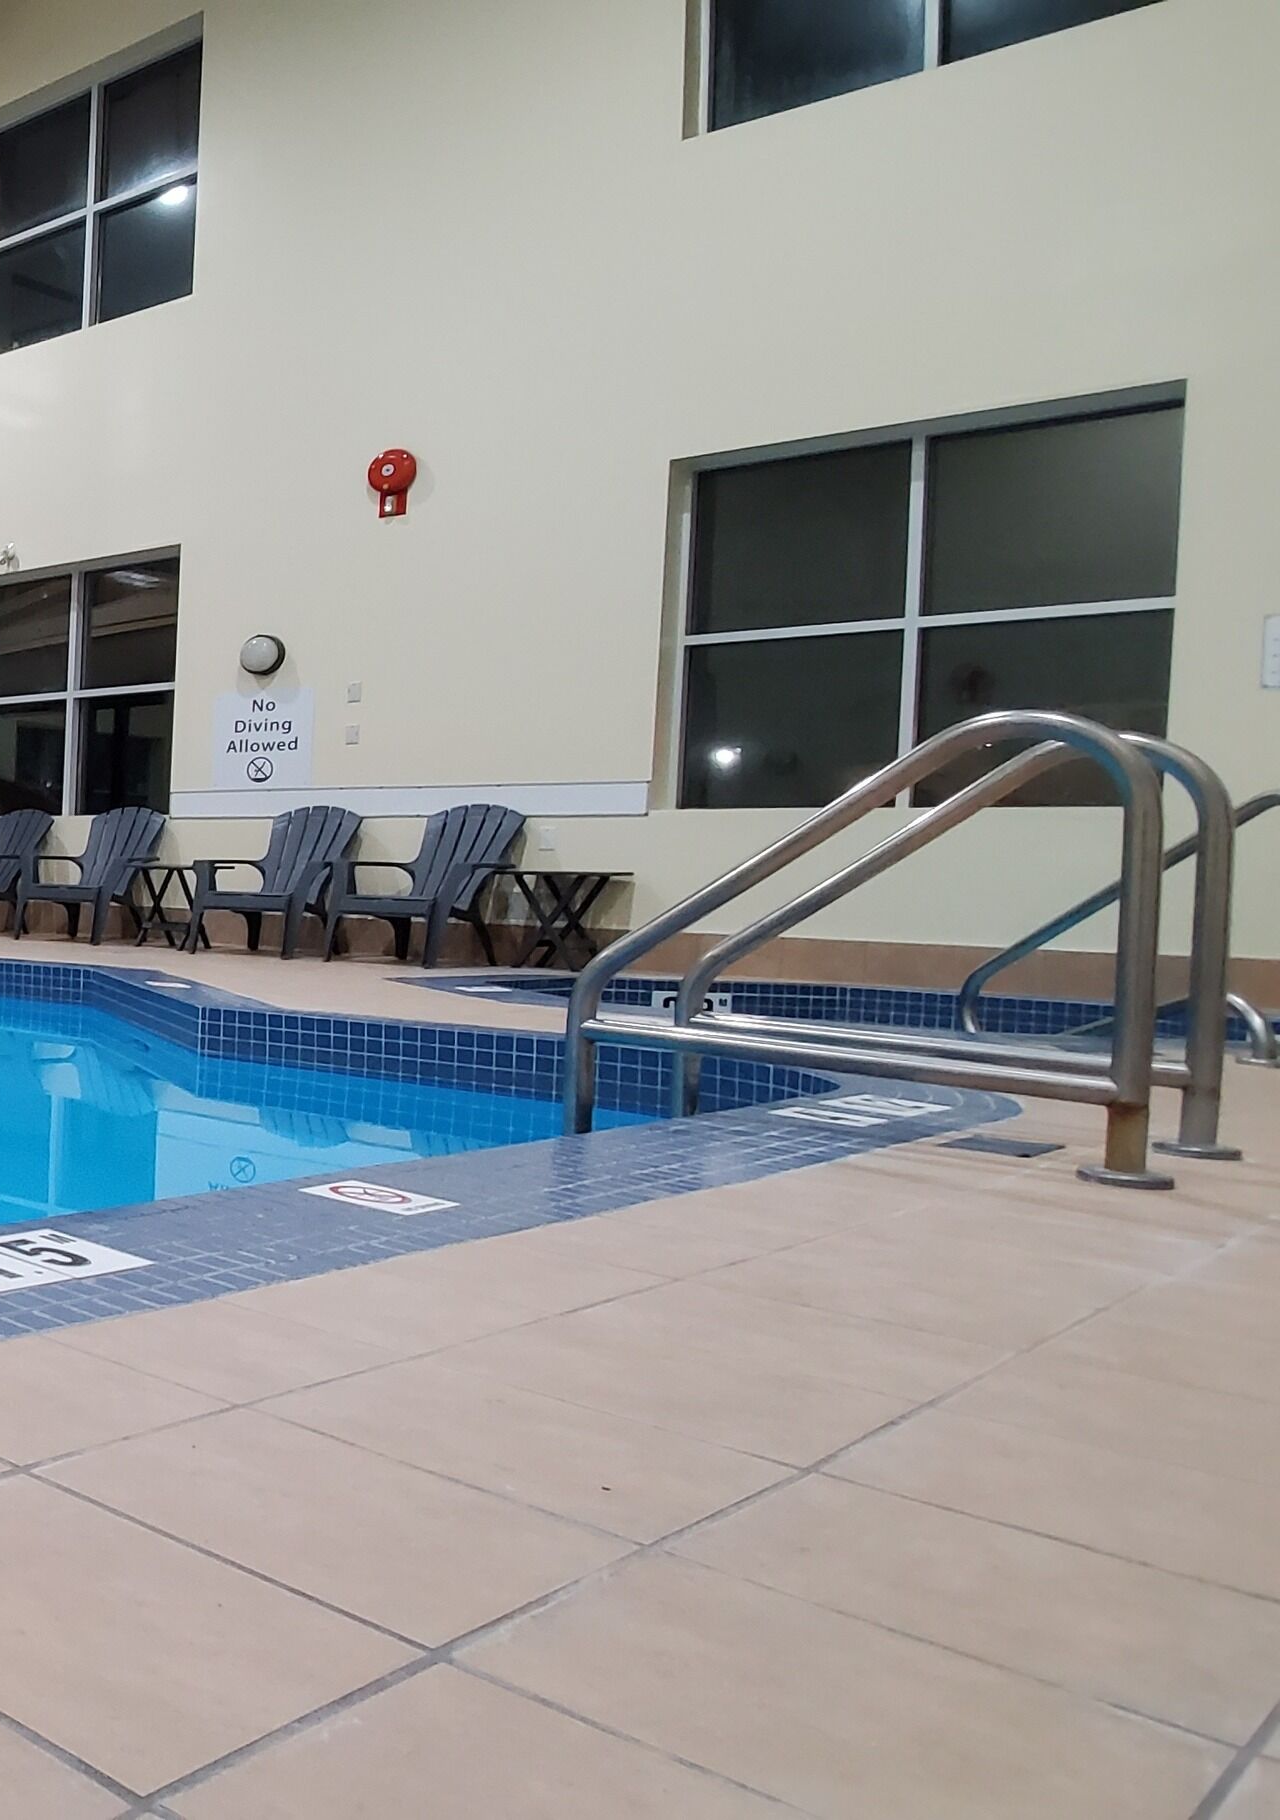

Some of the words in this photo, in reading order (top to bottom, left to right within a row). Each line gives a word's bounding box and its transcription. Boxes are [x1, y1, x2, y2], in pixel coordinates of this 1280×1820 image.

[252, 698, 276, 712] No
[234, 718, 292, 734] Diving
[226, 736, 299, 753] Allowed
